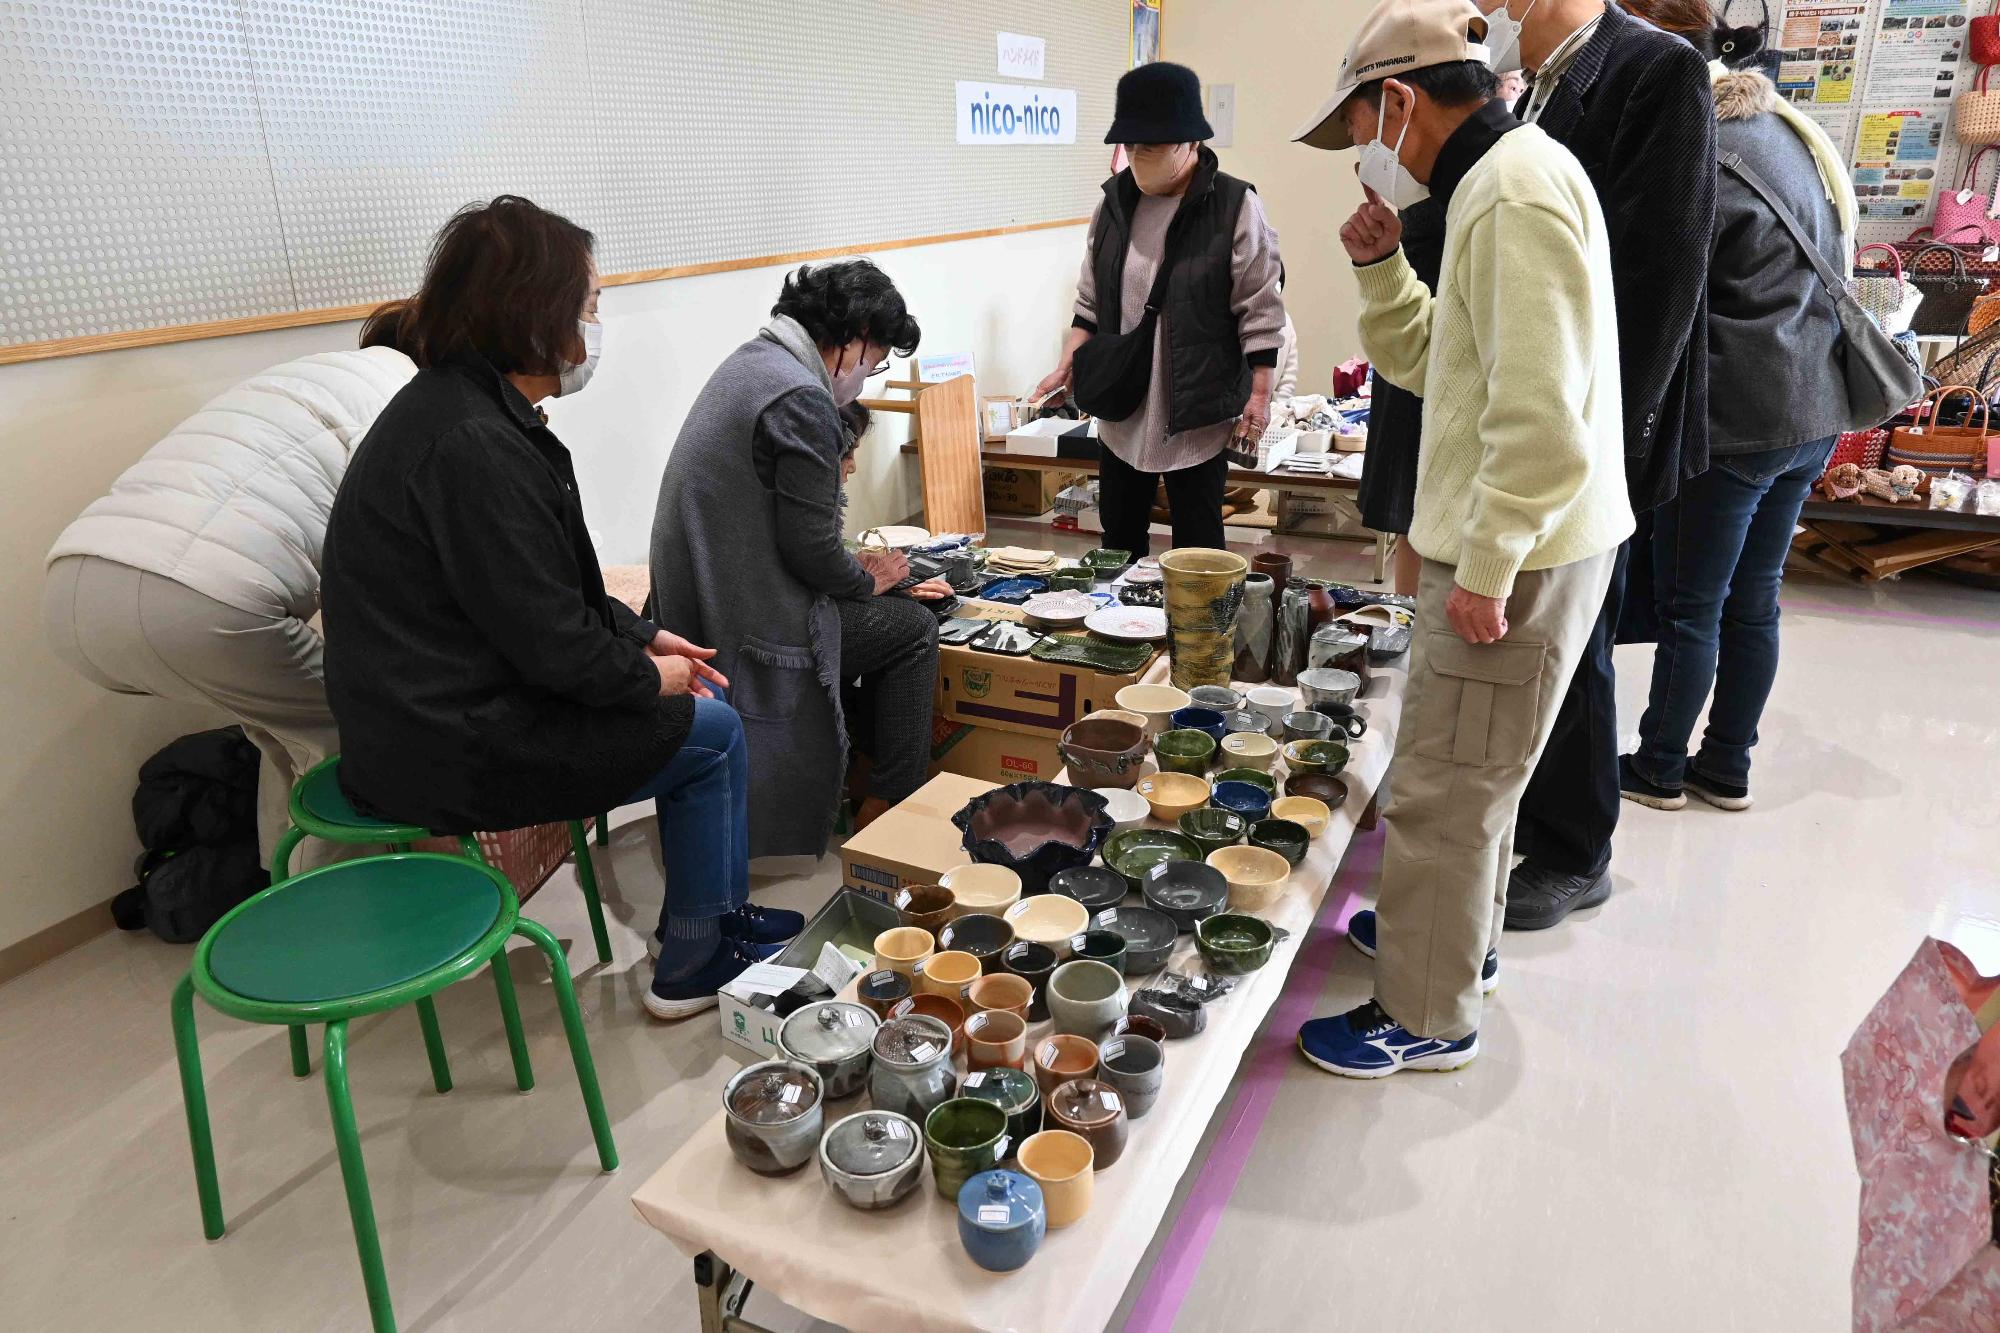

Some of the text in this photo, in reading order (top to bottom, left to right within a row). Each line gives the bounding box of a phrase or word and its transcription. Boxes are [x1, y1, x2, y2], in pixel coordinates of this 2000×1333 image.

[1375, 54, 1415, 69] YAMANASHI
[970, 91, 1060, 135] nico-nico
[1005, 758, 1034, 771] OL-60
